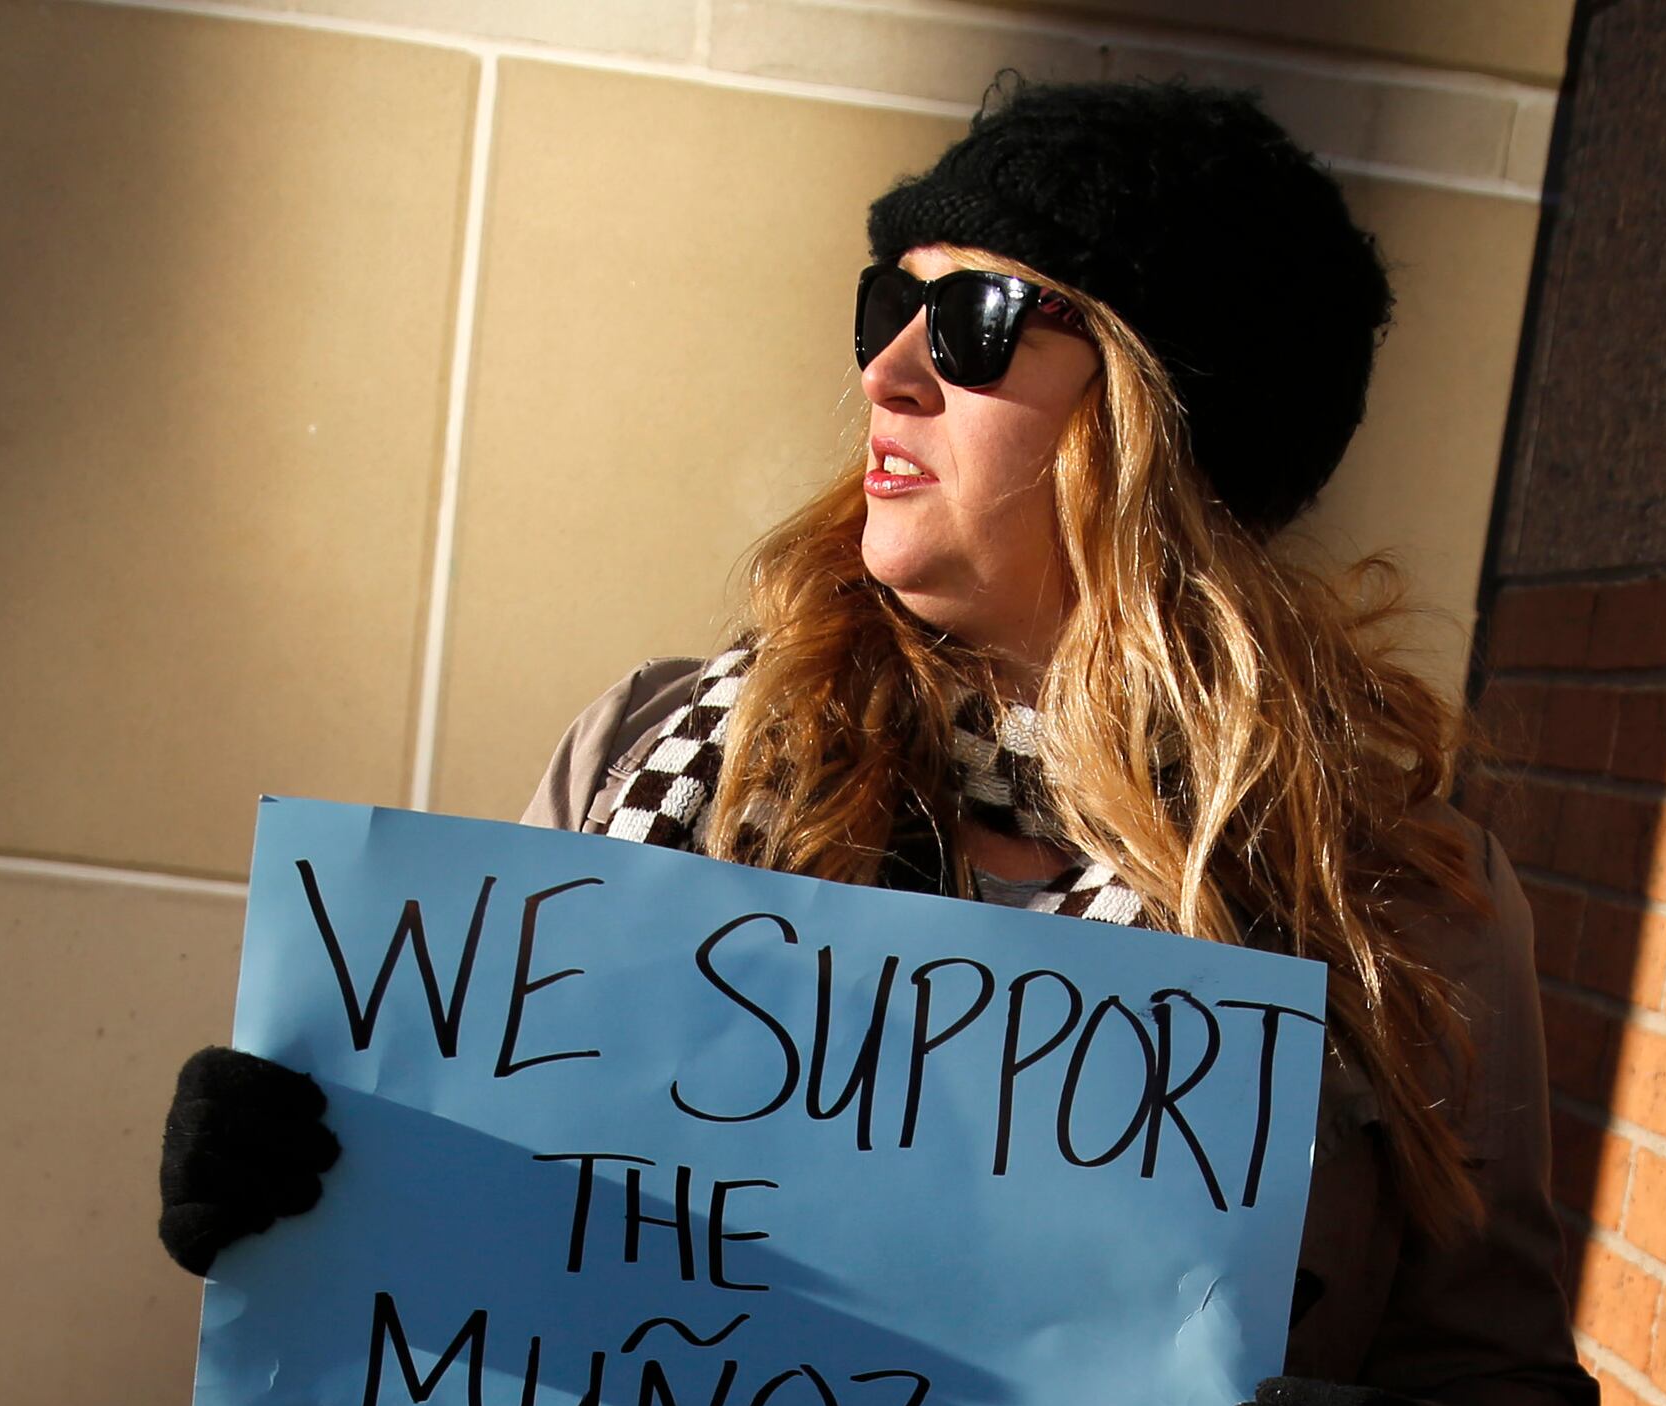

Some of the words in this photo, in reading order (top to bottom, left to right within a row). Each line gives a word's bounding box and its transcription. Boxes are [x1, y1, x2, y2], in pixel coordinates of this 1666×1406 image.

[295, 858, 605, 1078] WE
[669, 912, 1326, 1212] SUPPORT
[533, 1150, 780, 1292] THE
